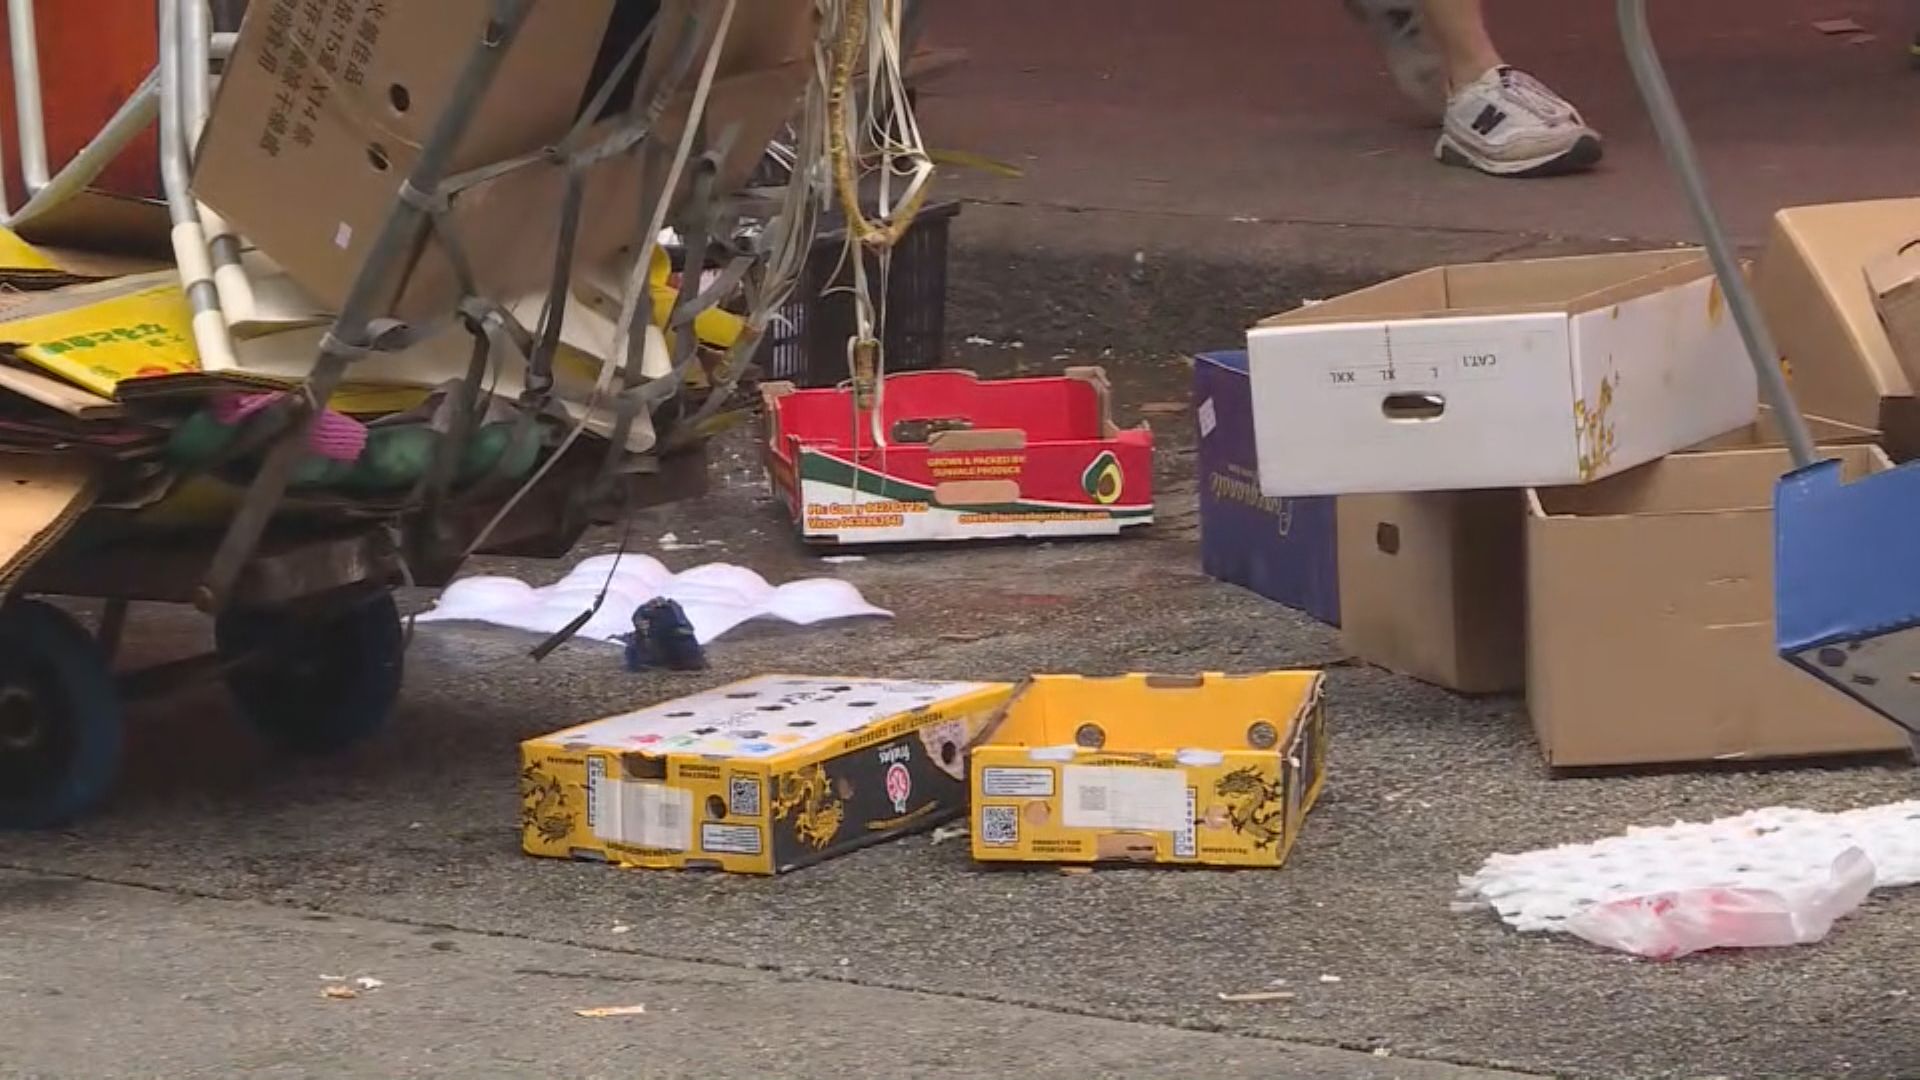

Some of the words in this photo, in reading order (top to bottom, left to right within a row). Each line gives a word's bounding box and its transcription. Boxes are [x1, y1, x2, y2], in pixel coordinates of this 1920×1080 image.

[1328, 371, 1356, 384] XXL
[1378, 369, 1396, 381] XL
[1428, 367, 1439, 380] L
